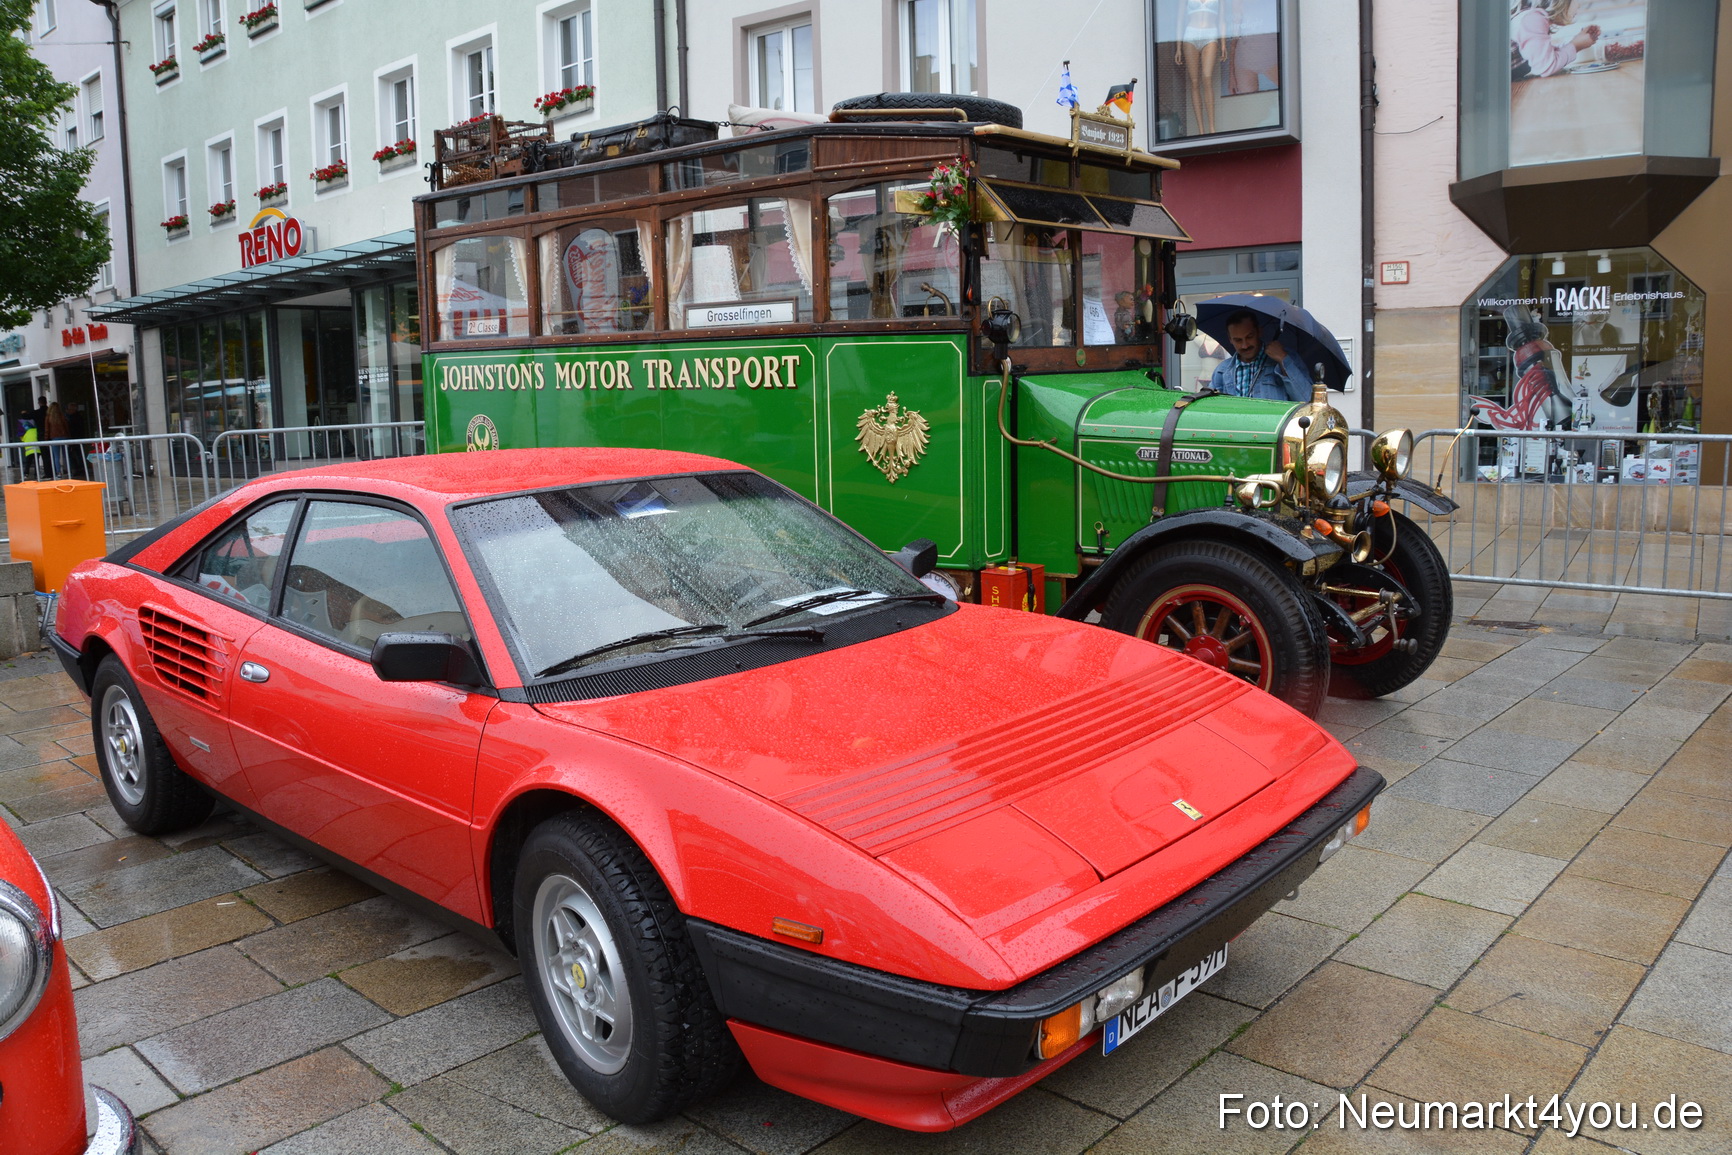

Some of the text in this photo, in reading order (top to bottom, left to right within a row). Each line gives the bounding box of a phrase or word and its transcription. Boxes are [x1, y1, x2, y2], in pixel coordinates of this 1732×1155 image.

[1081, 124, 1125, 144] Baujahr 1923
[238, 217, 303, 269] RENO
[1477, 297, 1538, 307] Willkommen
[1540, 296, 1553, 304] im
[1555, 286, 1611, 311] RACKL
[1613, 290, 1686, 302] Erlebnishaus.
[707, 307, 772, 323] Grosselfingen
[477, 322, 498, 333] Classe
[440, 355, 800, 391] JOHNSTON'S MOTOR TRANSPORT
[1140, 449, 1207, 461] INTEATIONAL
[991, 585, 1000, 607] SH
[1108, 1031, 1115, 1044] D
[1119, 989, 1160, 1039] NEA
